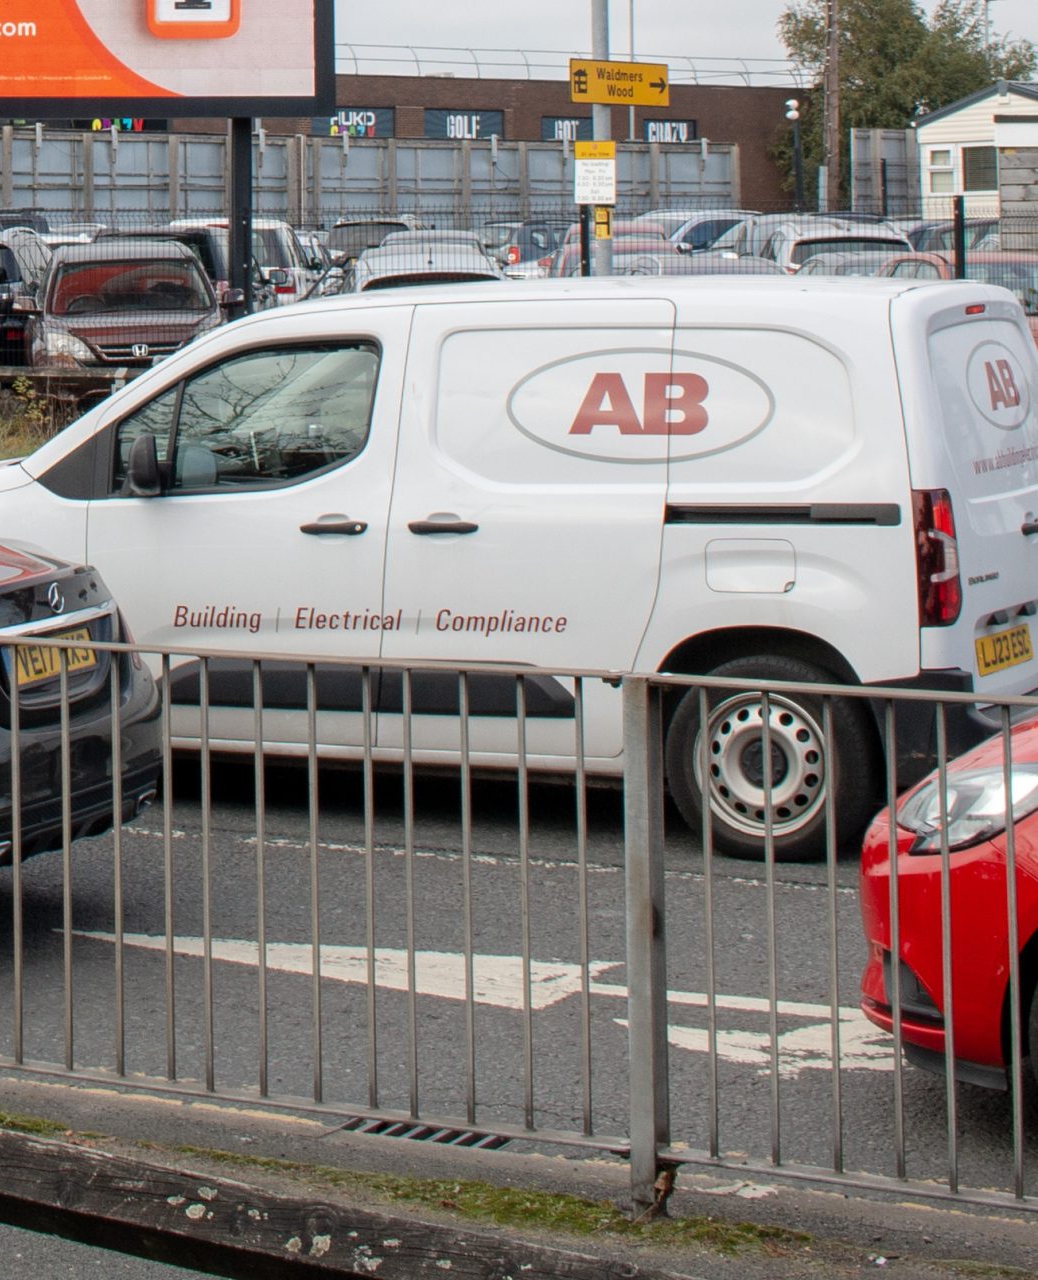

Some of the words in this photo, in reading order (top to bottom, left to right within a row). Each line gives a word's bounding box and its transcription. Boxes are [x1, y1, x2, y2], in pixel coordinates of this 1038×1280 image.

[596, 67, 644, 83] Waldmers
[607, 83, 634, 98] Wood
[447, 115, 480, 139] GOLF
[984, 359, 1020, 411] AB
[568, 371, 710, 435] AB
[173, 605, 262, 633] Building
[294, 607, 403, 631] Electrical
[435, 609, 567, 637] Compliance
[981, 635, 1011, 668] LJ23
[1010, 628, 1030, 659] ESC
